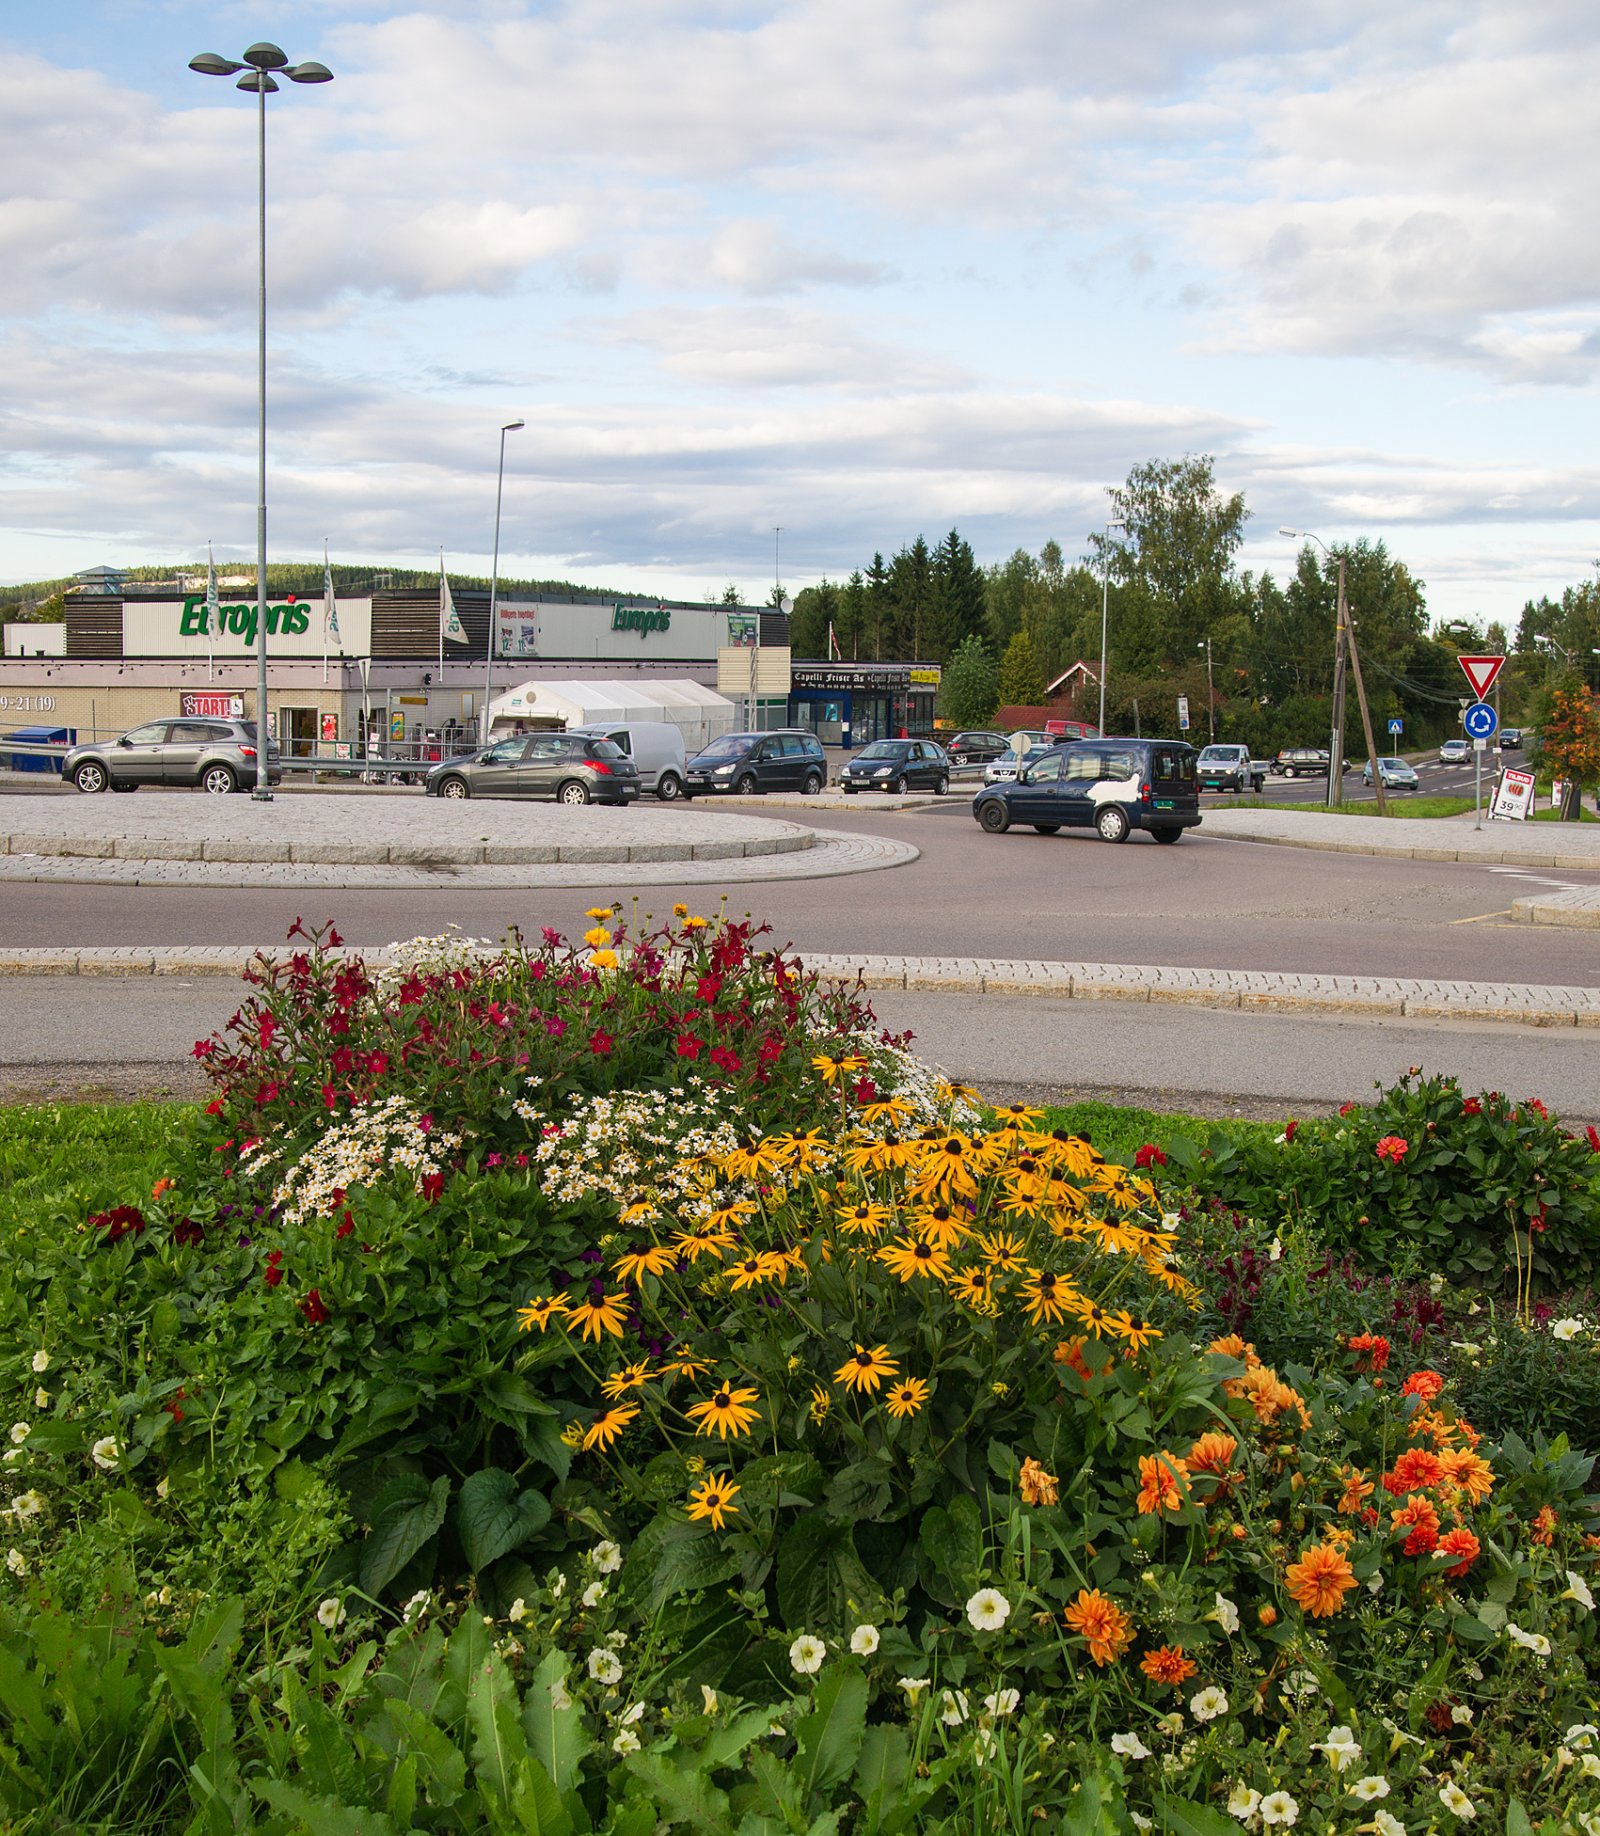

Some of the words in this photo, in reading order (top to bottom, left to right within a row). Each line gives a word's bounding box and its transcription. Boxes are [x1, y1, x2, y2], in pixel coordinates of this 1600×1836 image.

[179, 594, 311, 646] Europris
[611, 603, 671, 640] Europris
[794, 672, 823, 682] Capelli
[34, 695, 56, 712] (19)
[1500, 800, 1514, 811] 39
